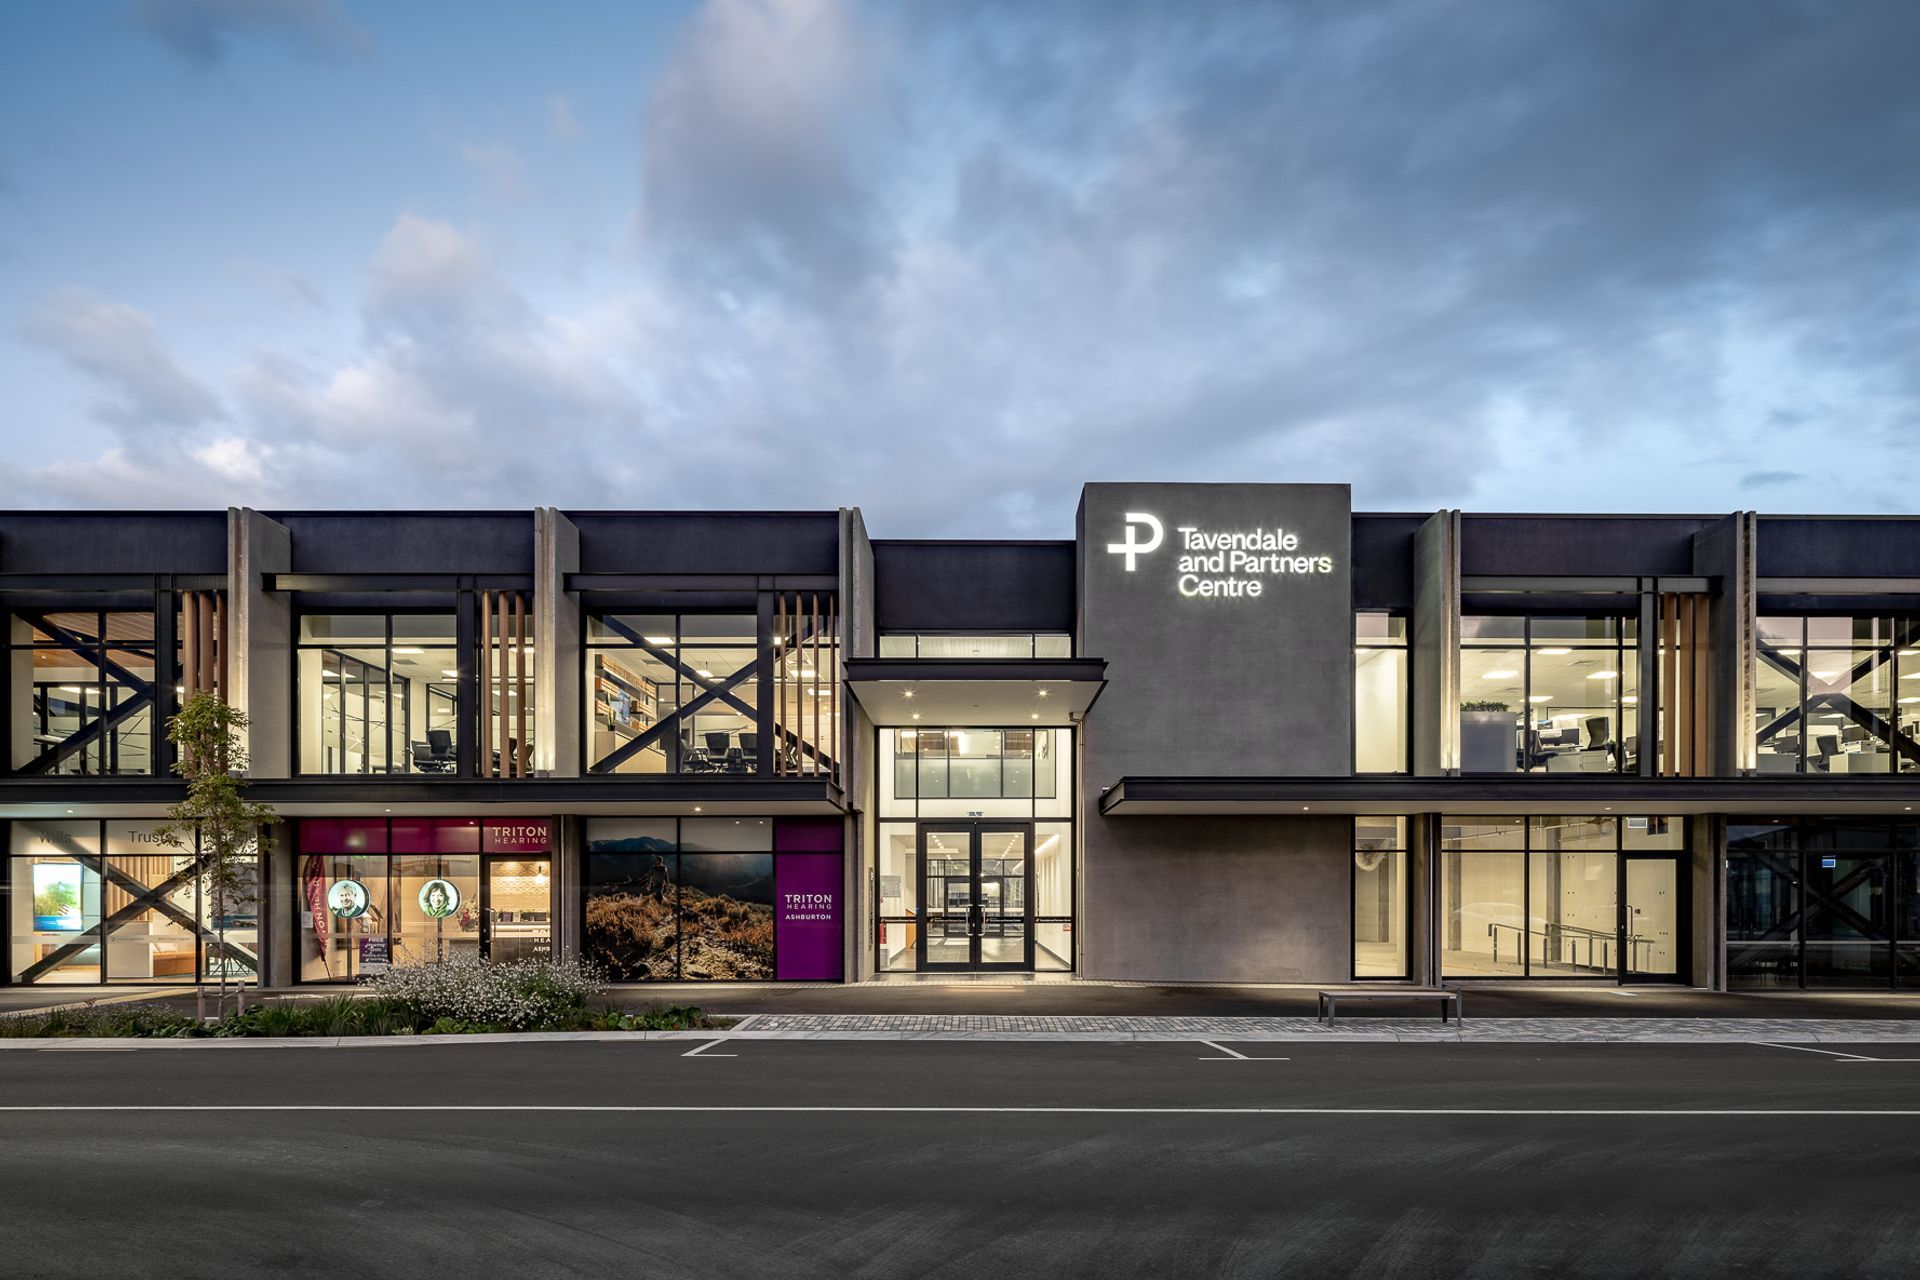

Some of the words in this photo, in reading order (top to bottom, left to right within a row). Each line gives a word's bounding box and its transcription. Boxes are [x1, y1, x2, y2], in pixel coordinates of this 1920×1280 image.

[1178, 527, 1298, 551] Tavendale
[1178, 551, 1224, 573] and
[1230, 551, 1333, 573] Partners
[1178, 574, 1262, 597] Centre
[39, 830, 72, 843] Wills
[492, 826, 547, 837] TRITON
[784, 894, 832, 903] TRITON
